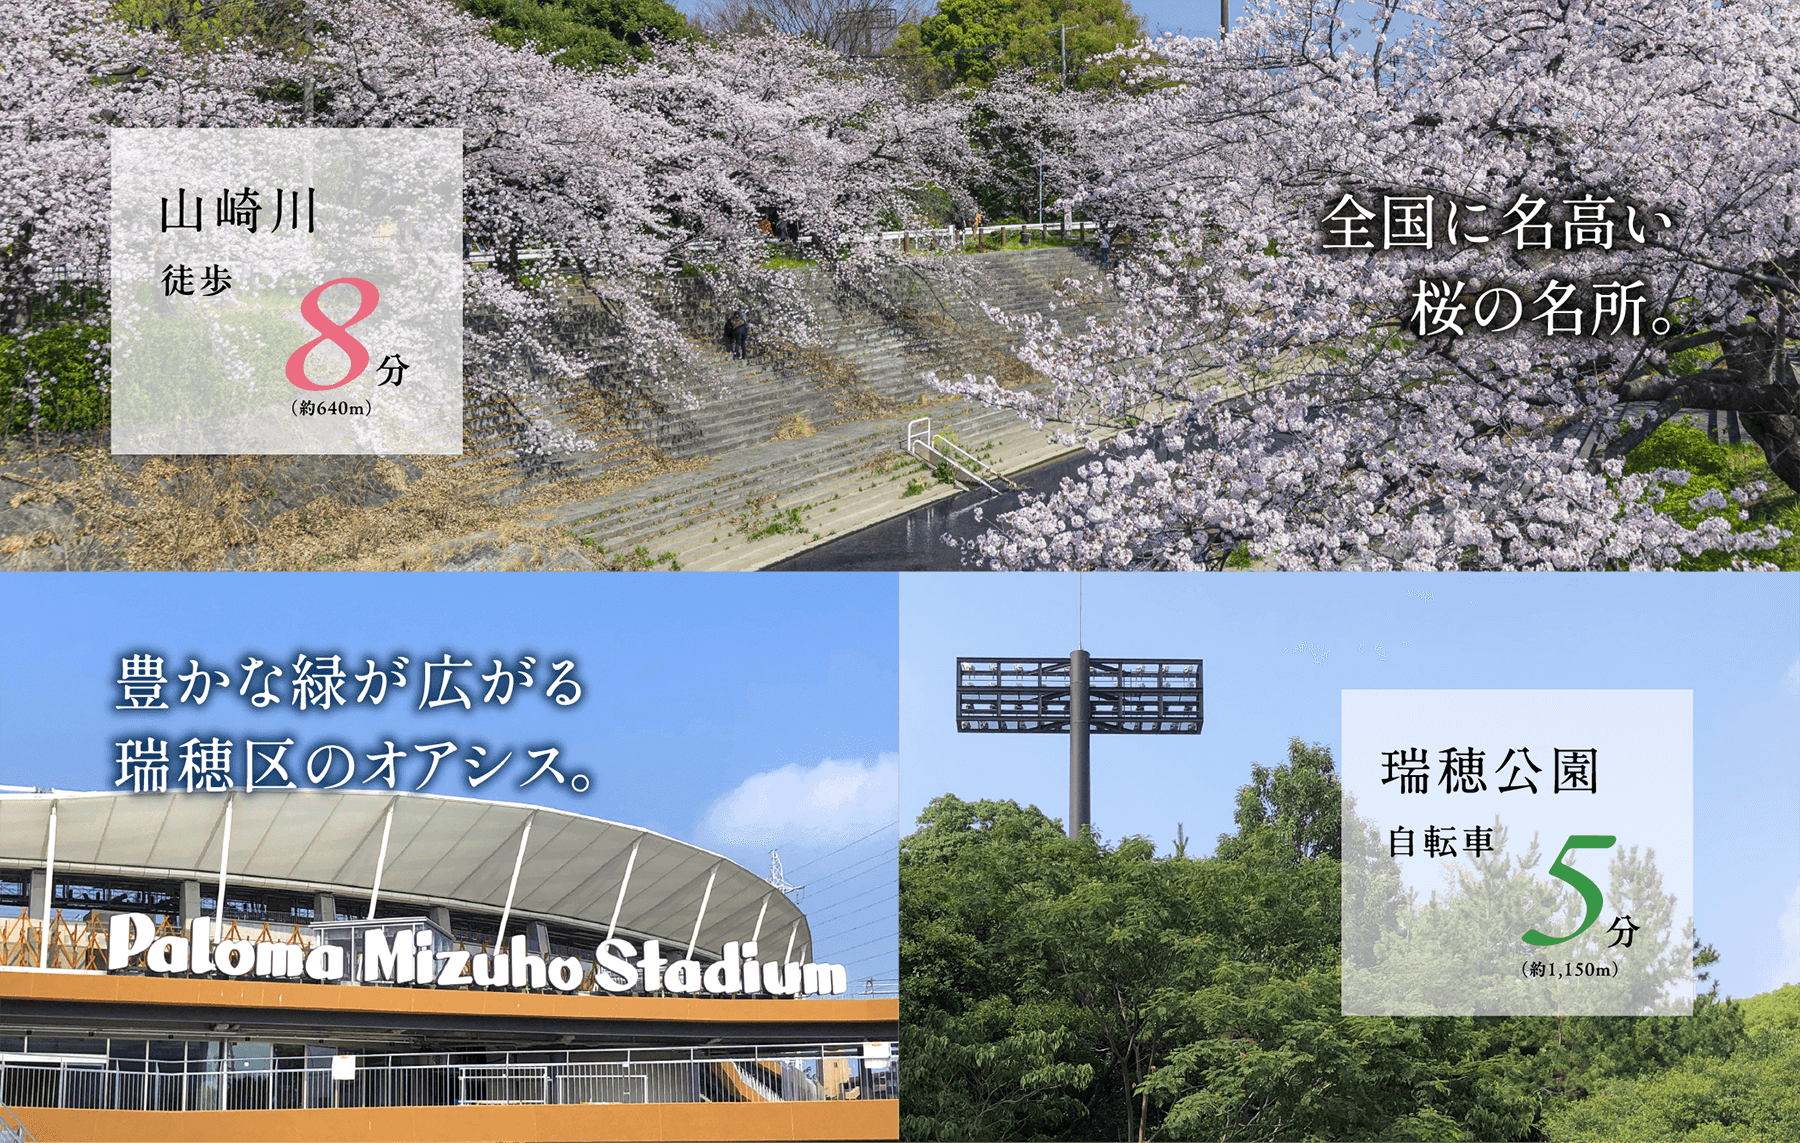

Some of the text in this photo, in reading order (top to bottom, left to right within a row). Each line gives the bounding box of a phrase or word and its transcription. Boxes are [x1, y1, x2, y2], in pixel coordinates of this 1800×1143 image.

[108, 912, 848, 996] Paloma Mizuho Stadium
